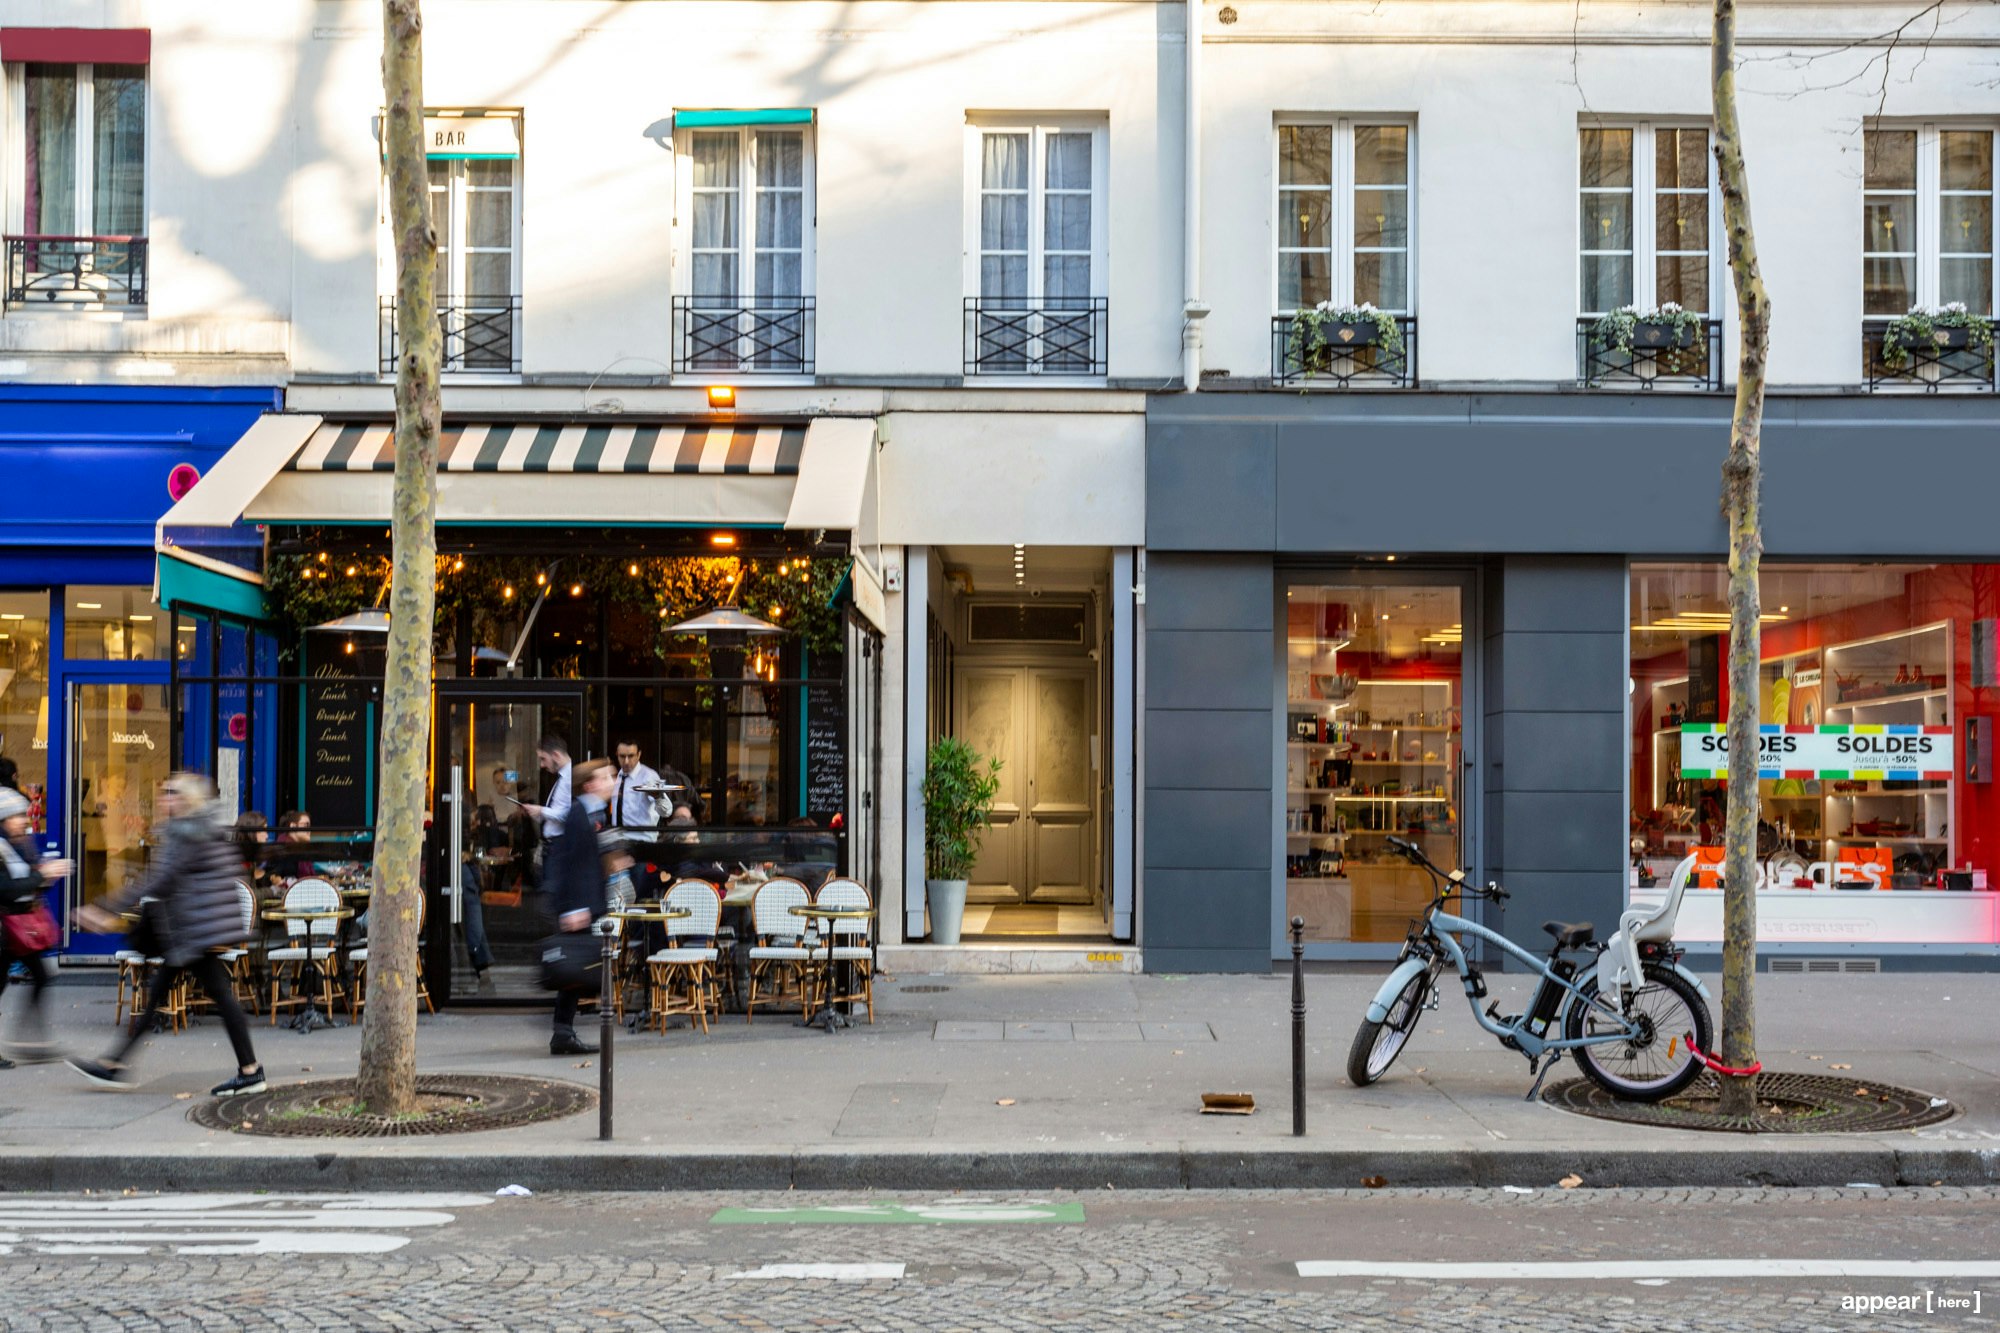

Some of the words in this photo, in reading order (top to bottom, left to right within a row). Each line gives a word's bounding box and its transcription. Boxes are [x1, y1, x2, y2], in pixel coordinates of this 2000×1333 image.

[435, 131, 465, 146] BAR
[320, 687, 348, 700] Lunch
[316, 708, 356, 725] Breakfast
[320, 727, 348, 740] Lunch
[1702, 735, 1797, 752] SOES
[1837, 736, 1933, 753] SOLDES
[316, 748, 351, 762] Dinner
[1759, 754, 1781, 762] 50%
[1891, 755, 1917, 763] -50%
[316, 774, 353, 786] Cocktails
